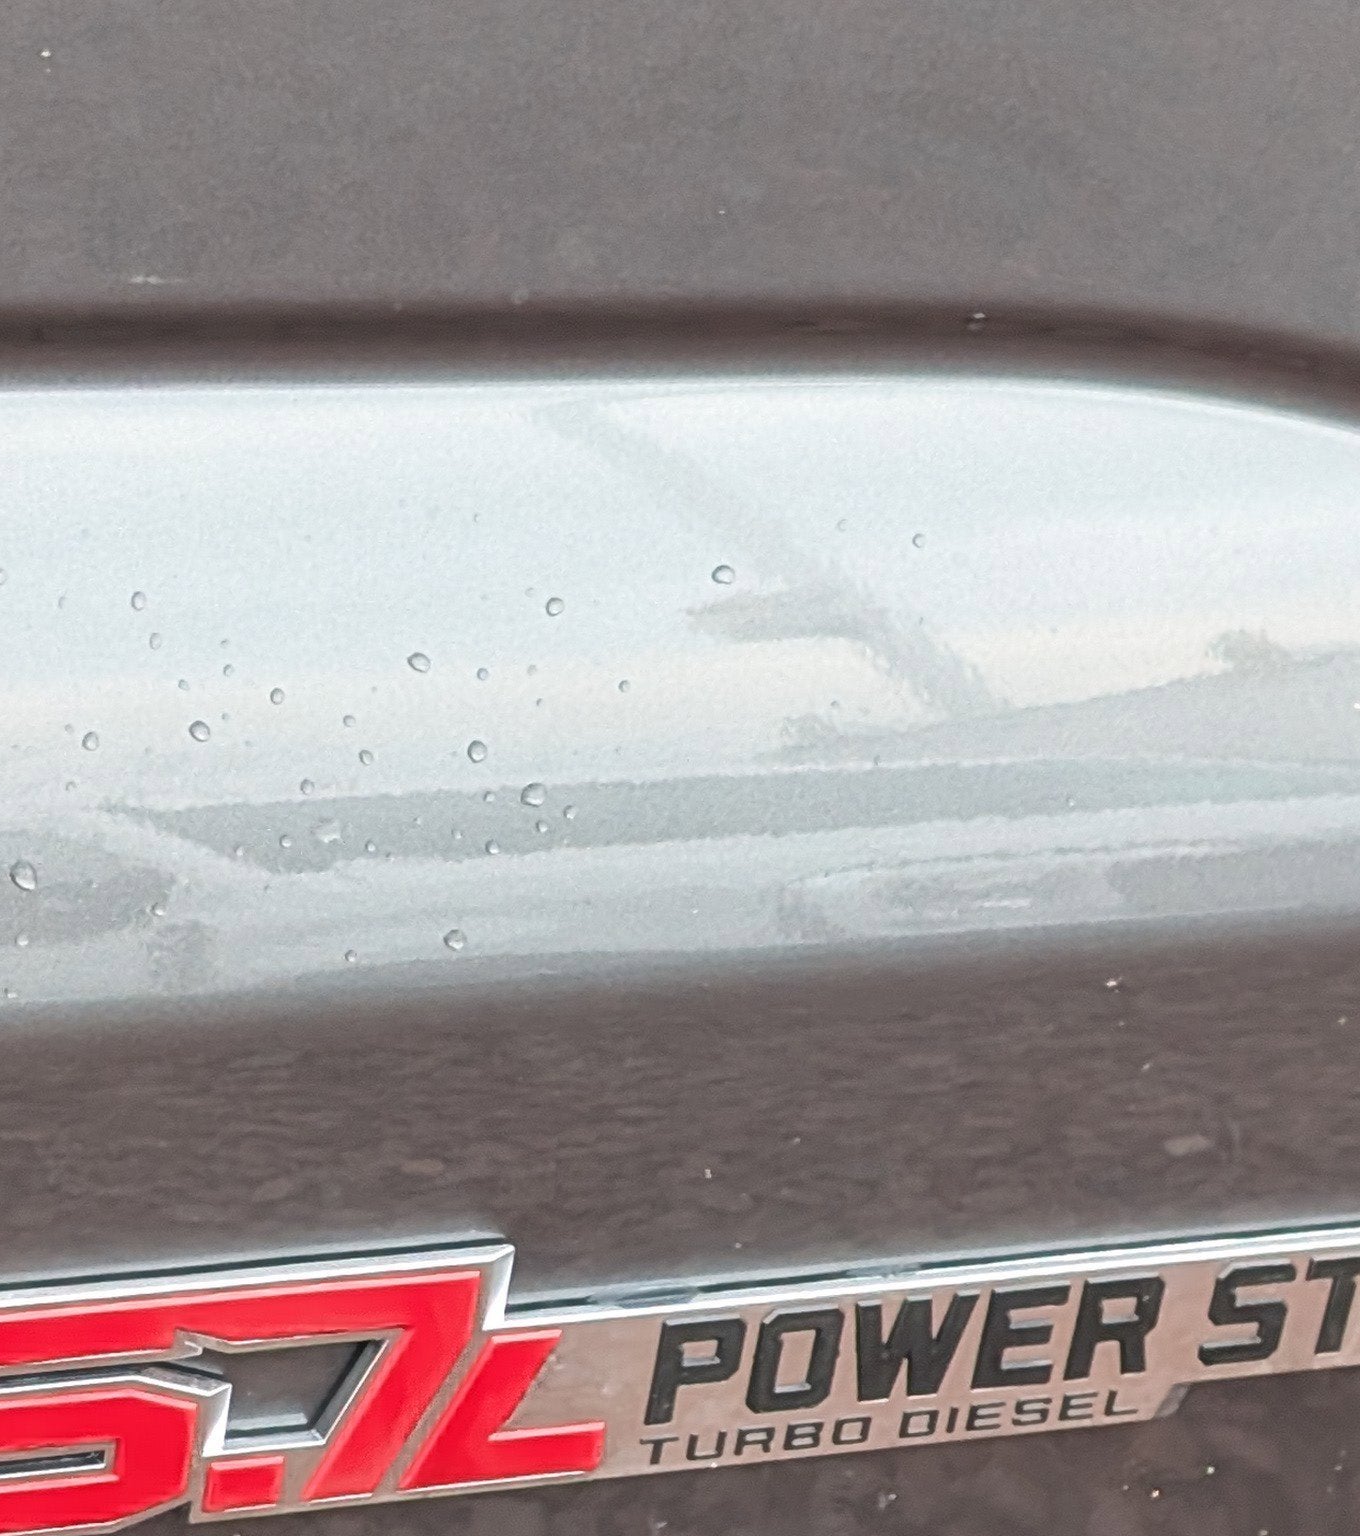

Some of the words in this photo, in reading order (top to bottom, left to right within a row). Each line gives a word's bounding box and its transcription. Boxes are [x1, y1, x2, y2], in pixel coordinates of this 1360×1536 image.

[643, 1273, 1166, 1427] POWER
[639, 1415, 872, 1466] TURBO
[897, 1389, 1140, 1440] DIESEL
